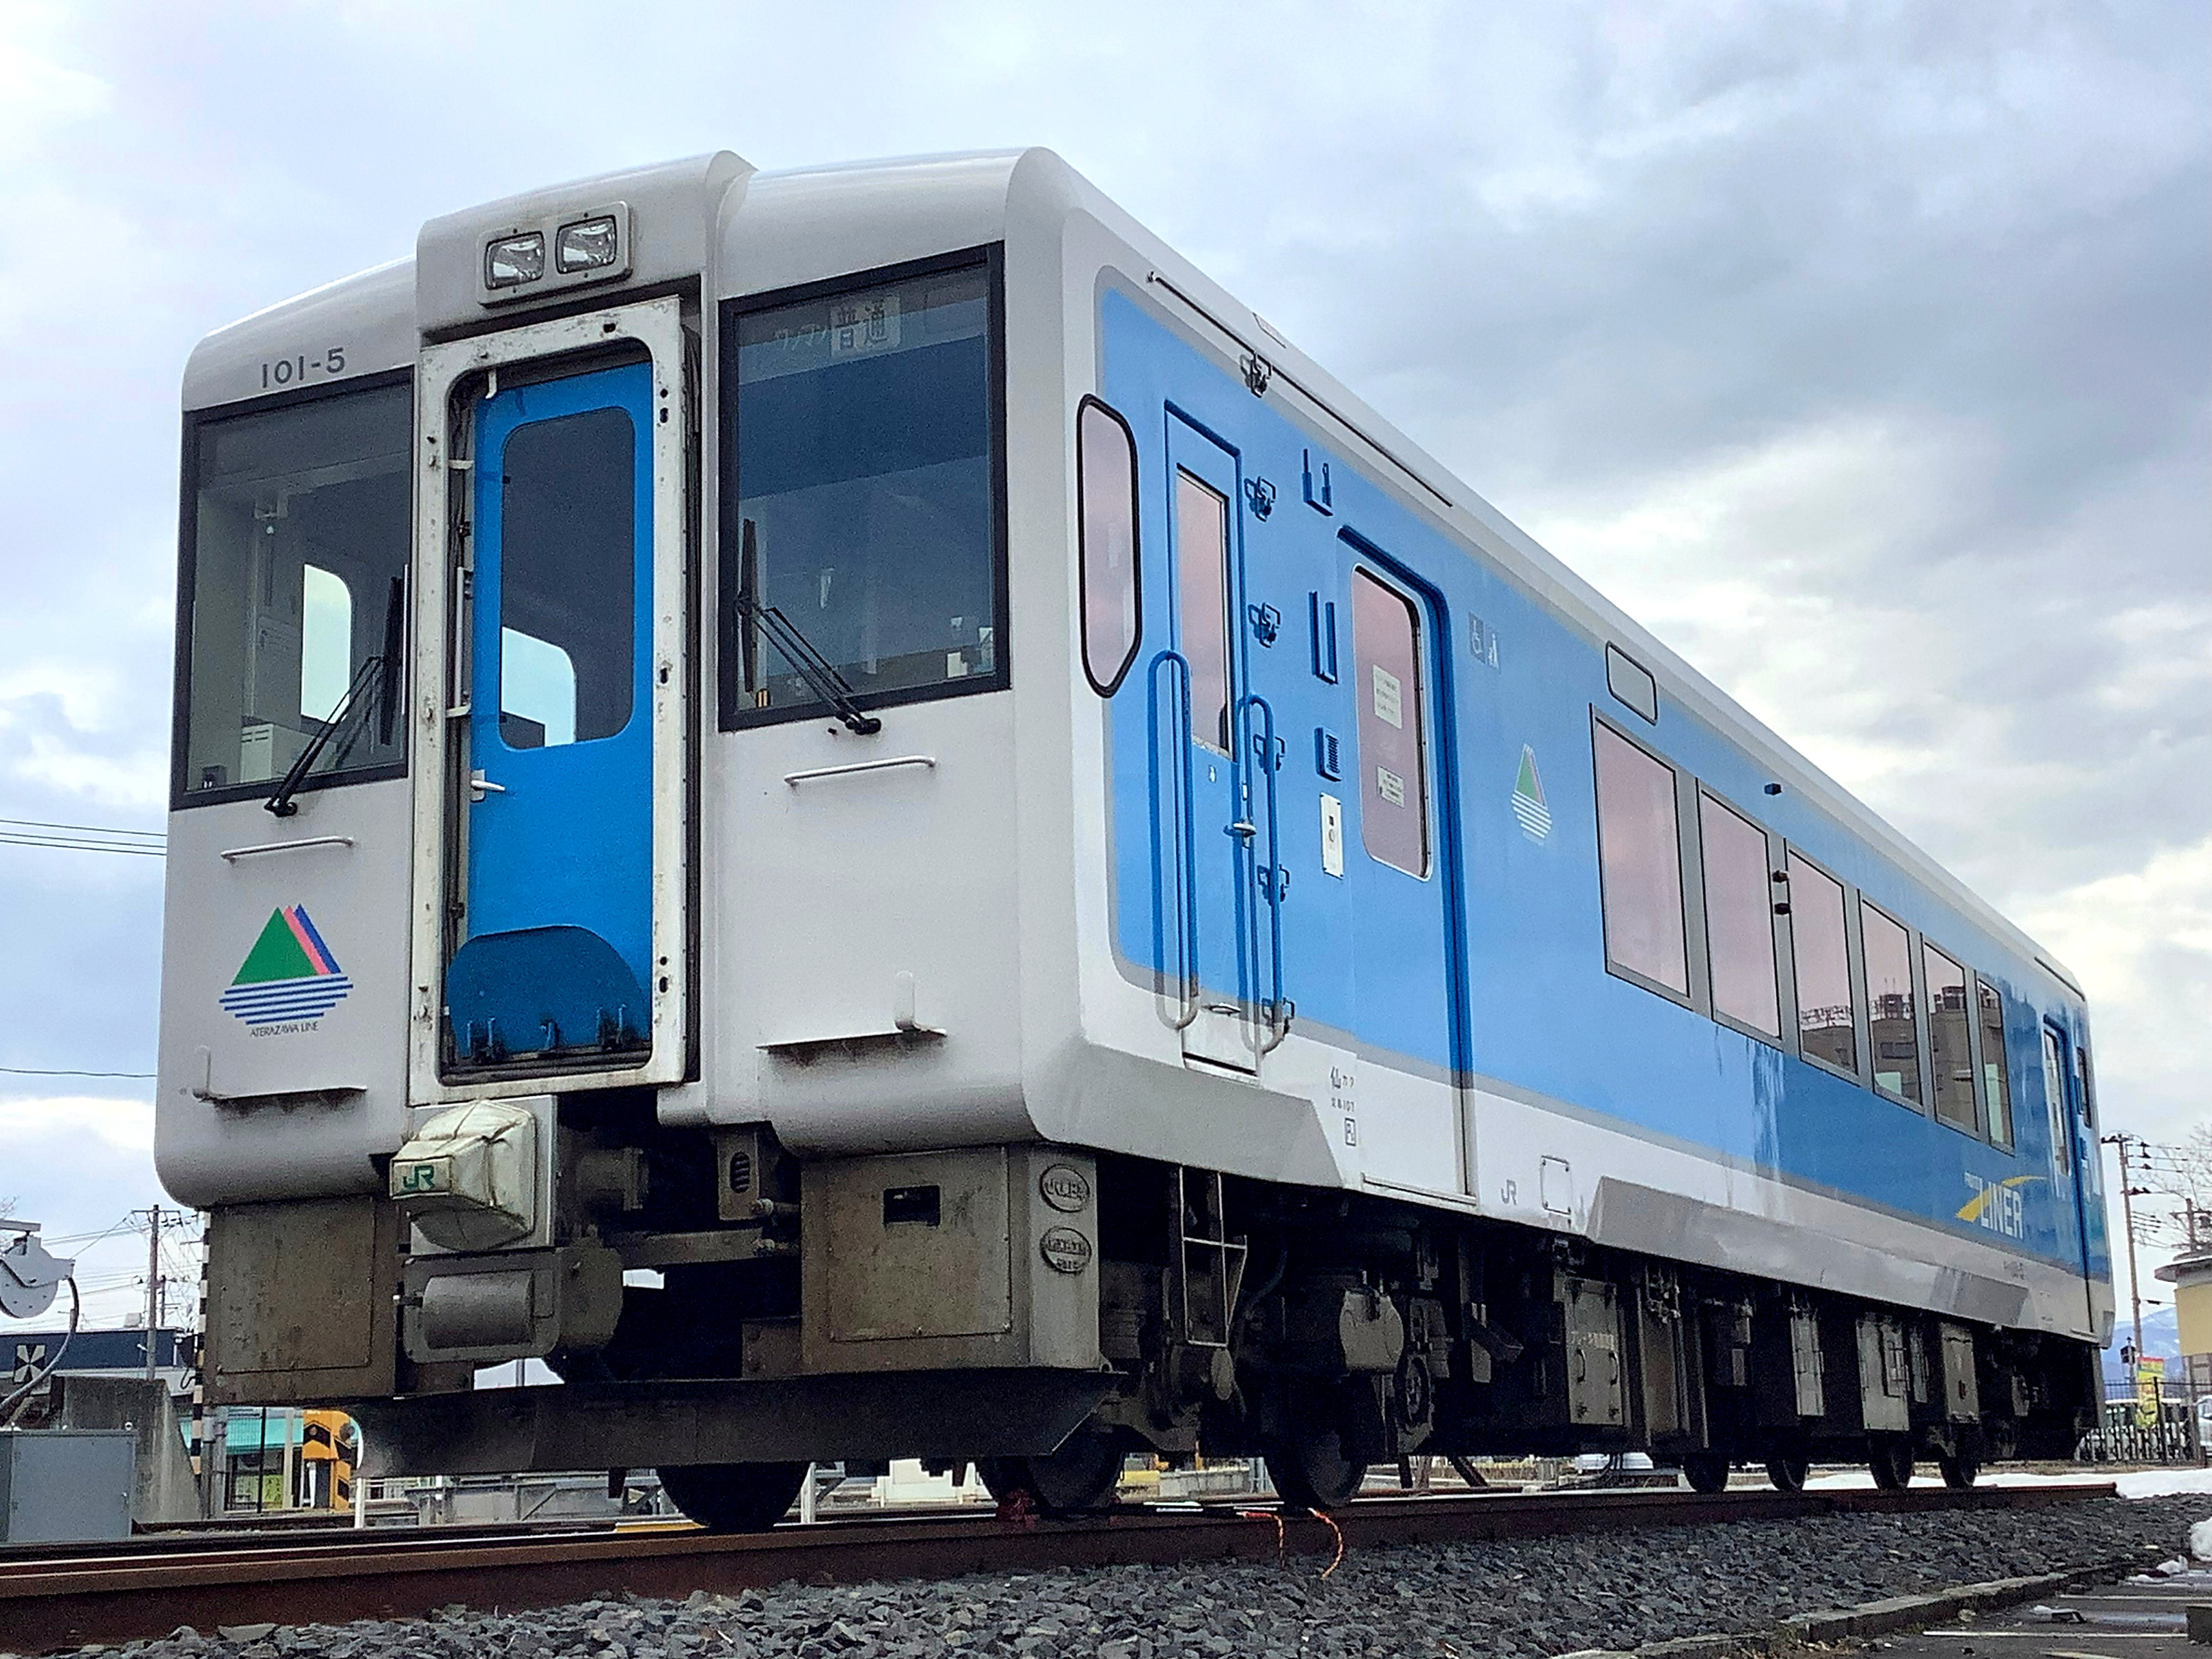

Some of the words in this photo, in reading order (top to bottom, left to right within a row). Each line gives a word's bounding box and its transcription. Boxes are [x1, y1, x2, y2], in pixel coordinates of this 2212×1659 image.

[836, 300, 890, 351] 普通
[261, 347, 346, 389] 101-5
[249, 1024, 300, 1037] ATERAZAWA
[300, 1020, 319, 1033] LINE
[402, 1165, 435, 1189] JR
[1501, 1179, 1517, 1206] JR
